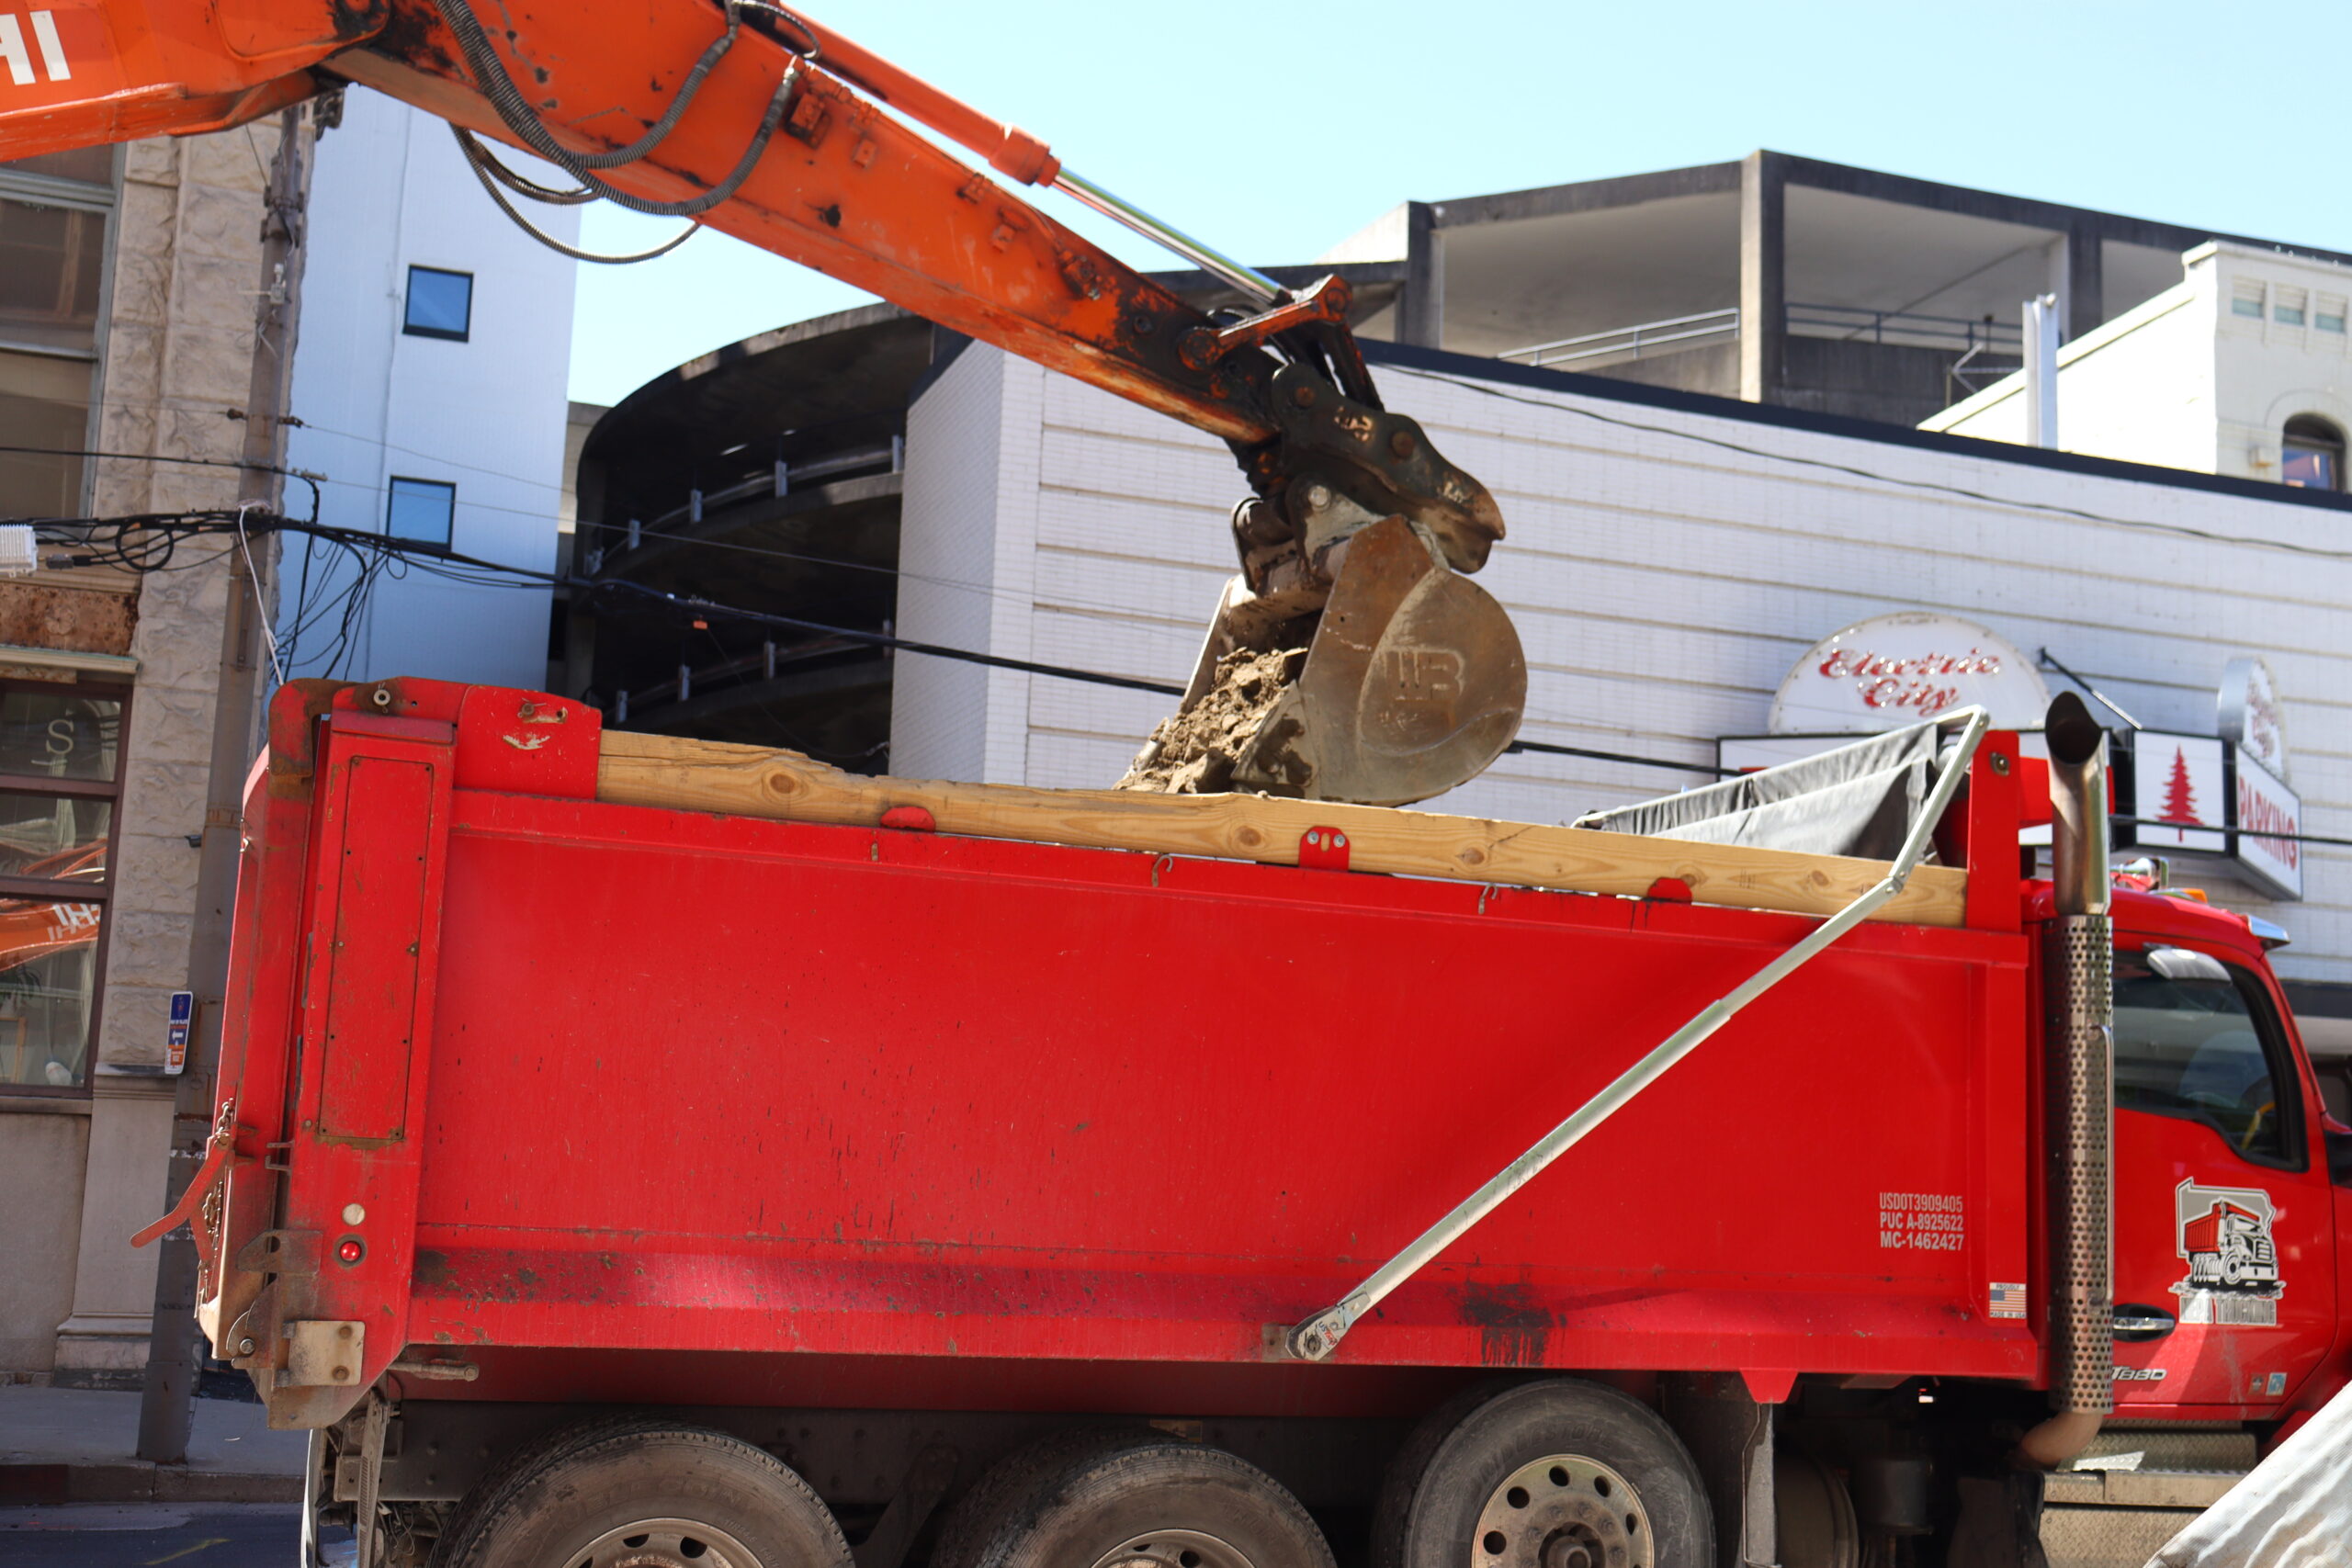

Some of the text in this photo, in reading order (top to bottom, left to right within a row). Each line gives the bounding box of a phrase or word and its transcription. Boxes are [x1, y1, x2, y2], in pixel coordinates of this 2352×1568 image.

[1819, 647, 2000, 678] Electric
[1859, 678, 1959, 716] City
[2239, 776, 2297, 870] PARKING
[1880, 1192, 1963, 1213] USDOT3909405
[1880, 1212, 1963, 1232] PUC A-8925622
[1881, 1231, 1964, 1251] MC-1462427
[2216, 1297, 2276, 1325] TRUCKING
[2111, 1365, 2167, 1381] T880
